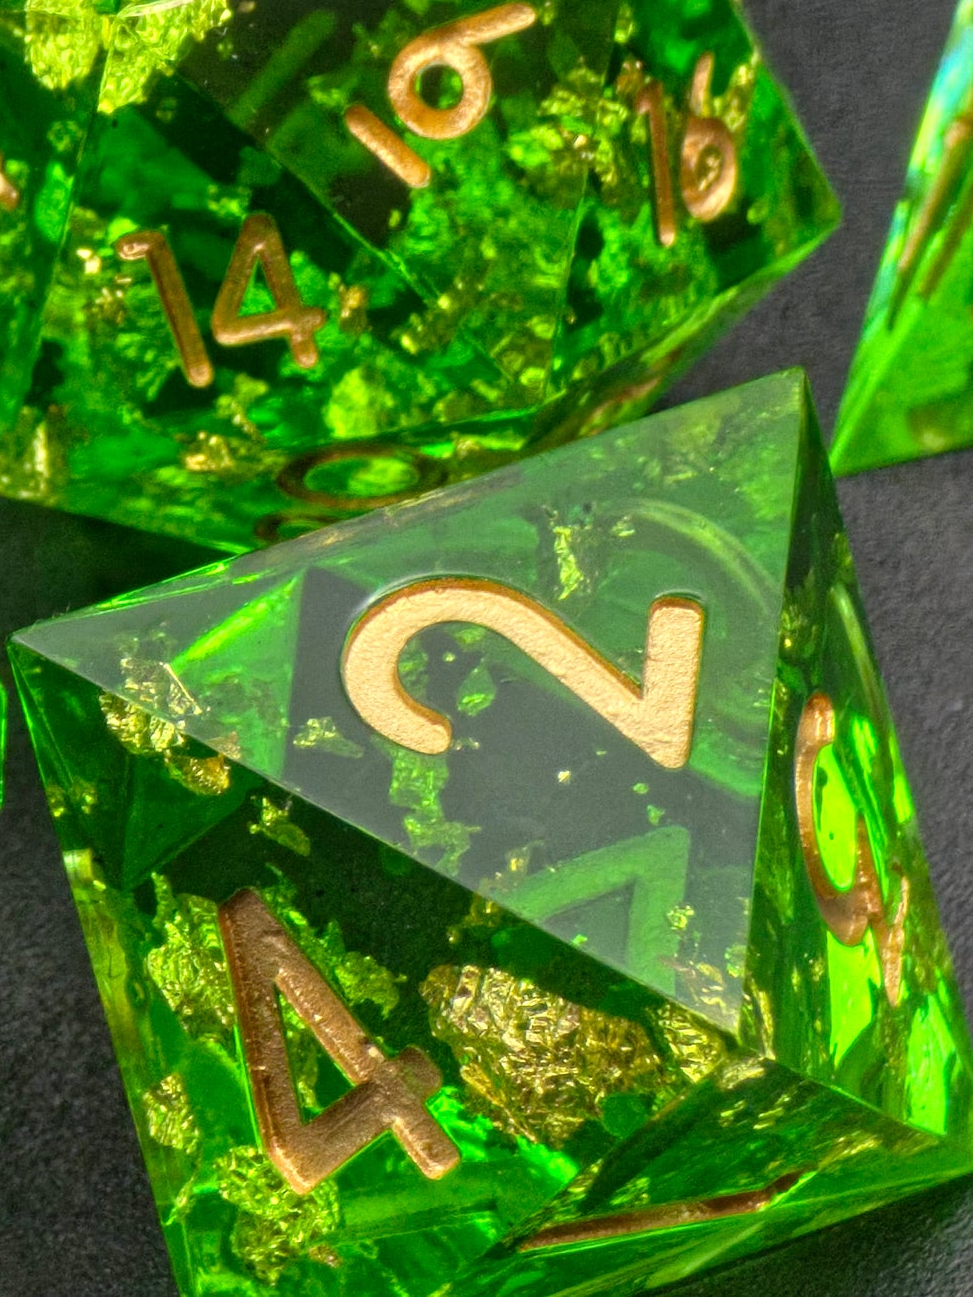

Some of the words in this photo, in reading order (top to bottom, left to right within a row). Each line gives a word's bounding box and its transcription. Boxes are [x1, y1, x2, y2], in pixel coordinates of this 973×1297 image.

[634, 50, 738, 248] 16
[115, 212, 327, 389] 14
[341, 575, 708, 770] 2
[218, 887, 462, 1196] 4
